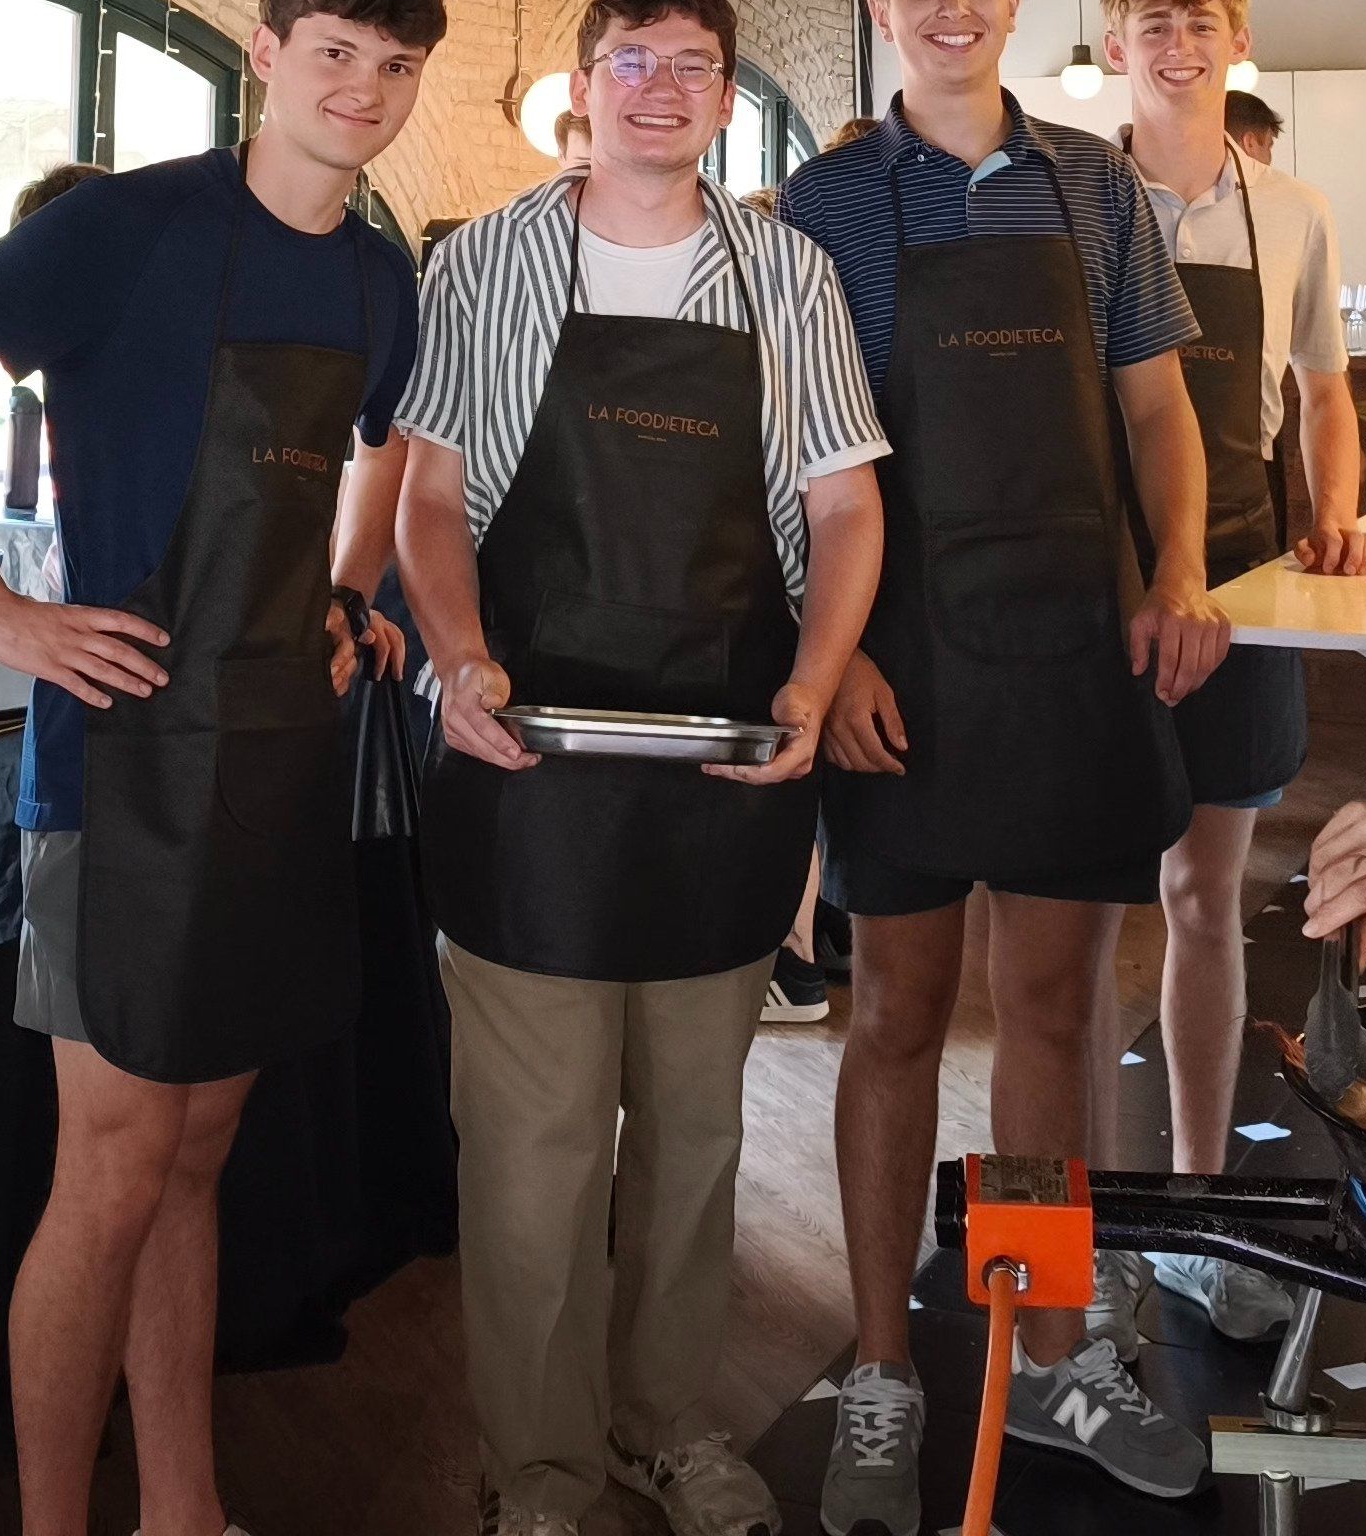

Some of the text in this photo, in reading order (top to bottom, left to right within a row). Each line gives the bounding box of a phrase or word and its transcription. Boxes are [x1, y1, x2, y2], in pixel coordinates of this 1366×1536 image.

[938, 328, 1065, 348] LA FOODIETECA
[1179, 345, 1236, 362] DIETECA
[588, 403, 720, 438] LA FOODIETECA
[252, 447, 276, 463] LA
